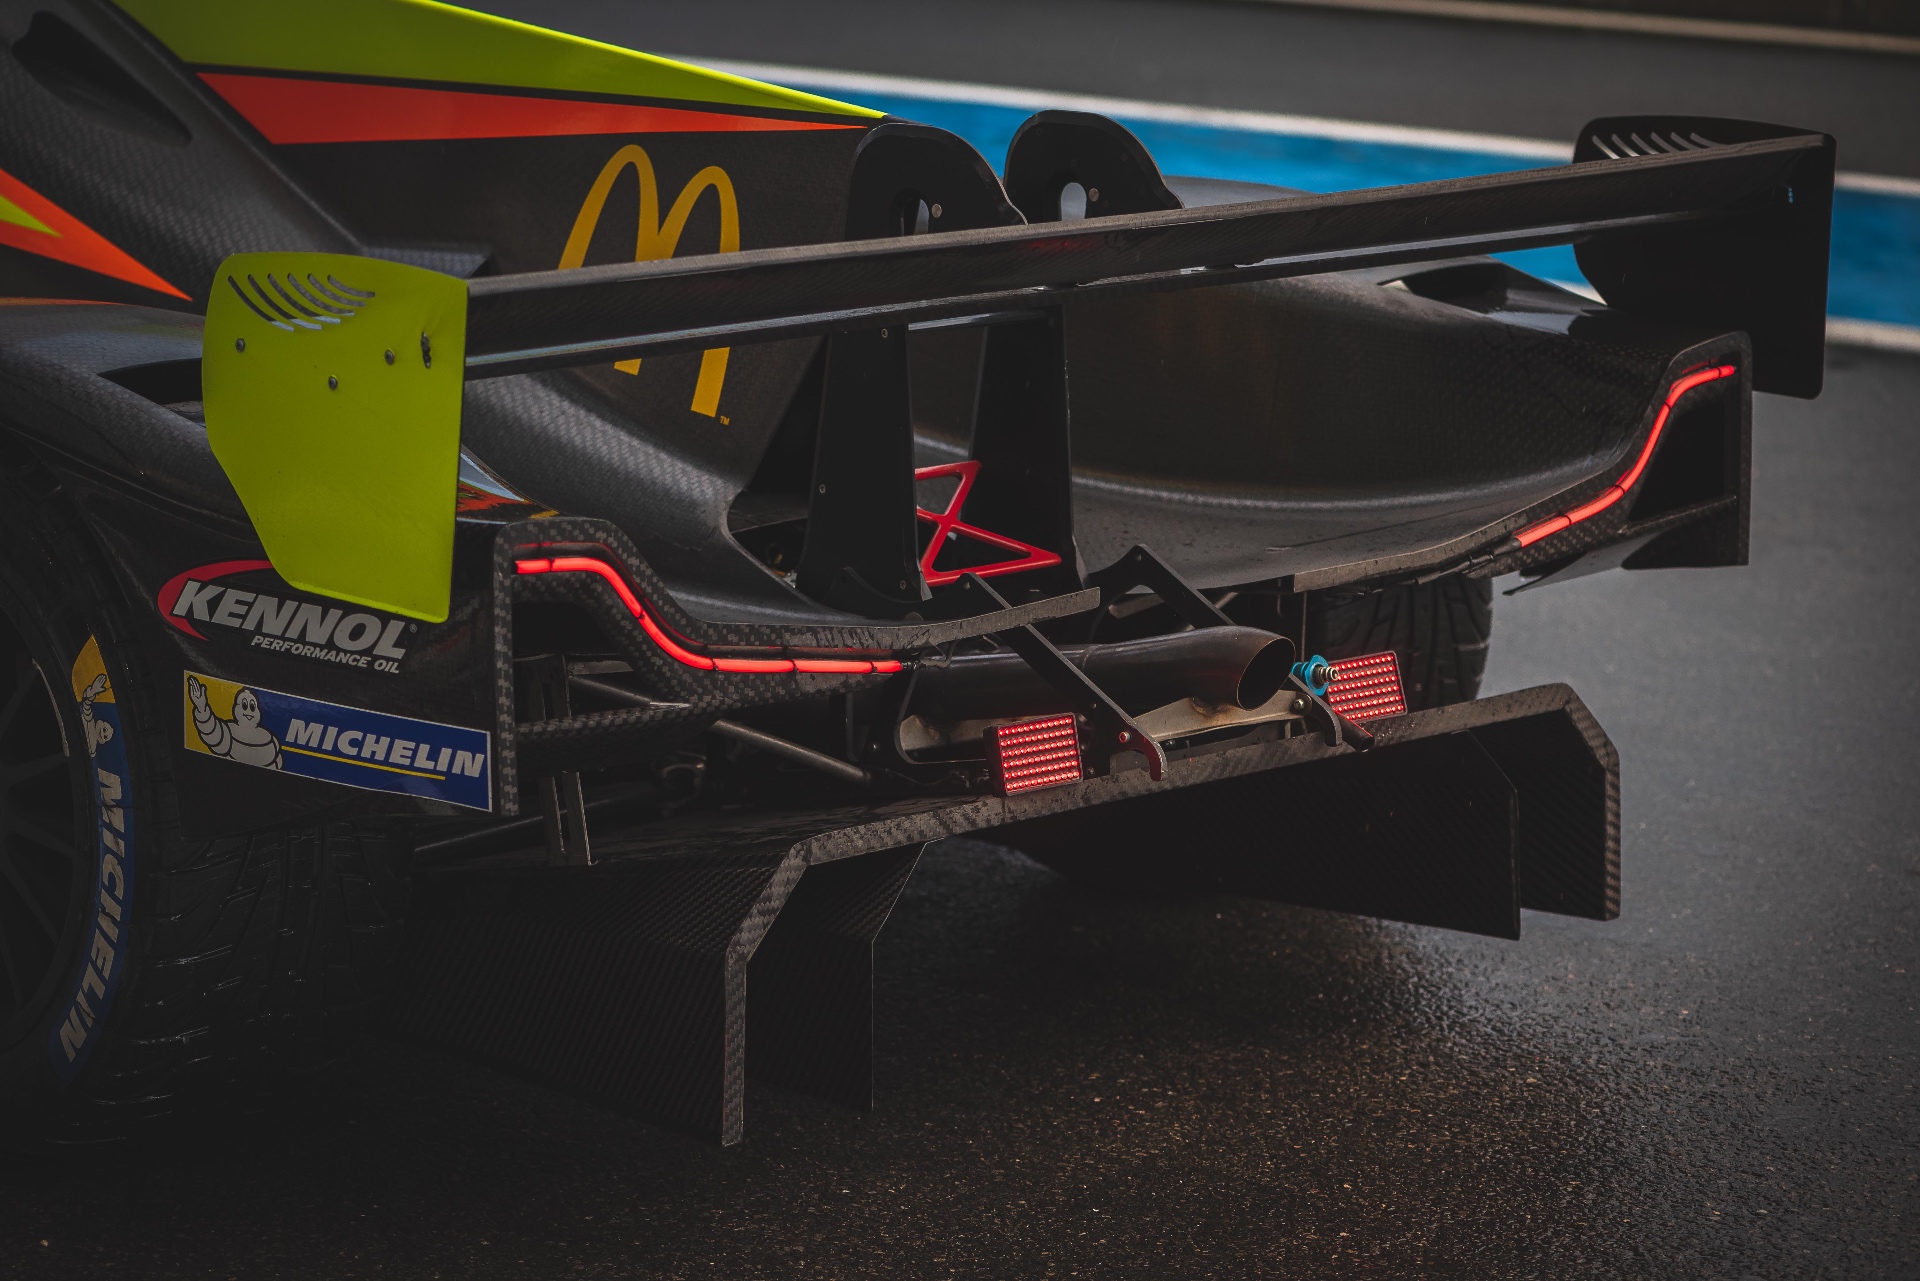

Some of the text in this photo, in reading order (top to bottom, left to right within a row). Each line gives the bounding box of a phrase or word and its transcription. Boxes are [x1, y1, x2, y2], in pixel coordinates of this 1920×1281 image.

[251, 635, 400, 674] PERFORMANCE OIL
[285, 719, 484, 778] MICHELIN
[60, 768, 125, 1063] MICHELIN
